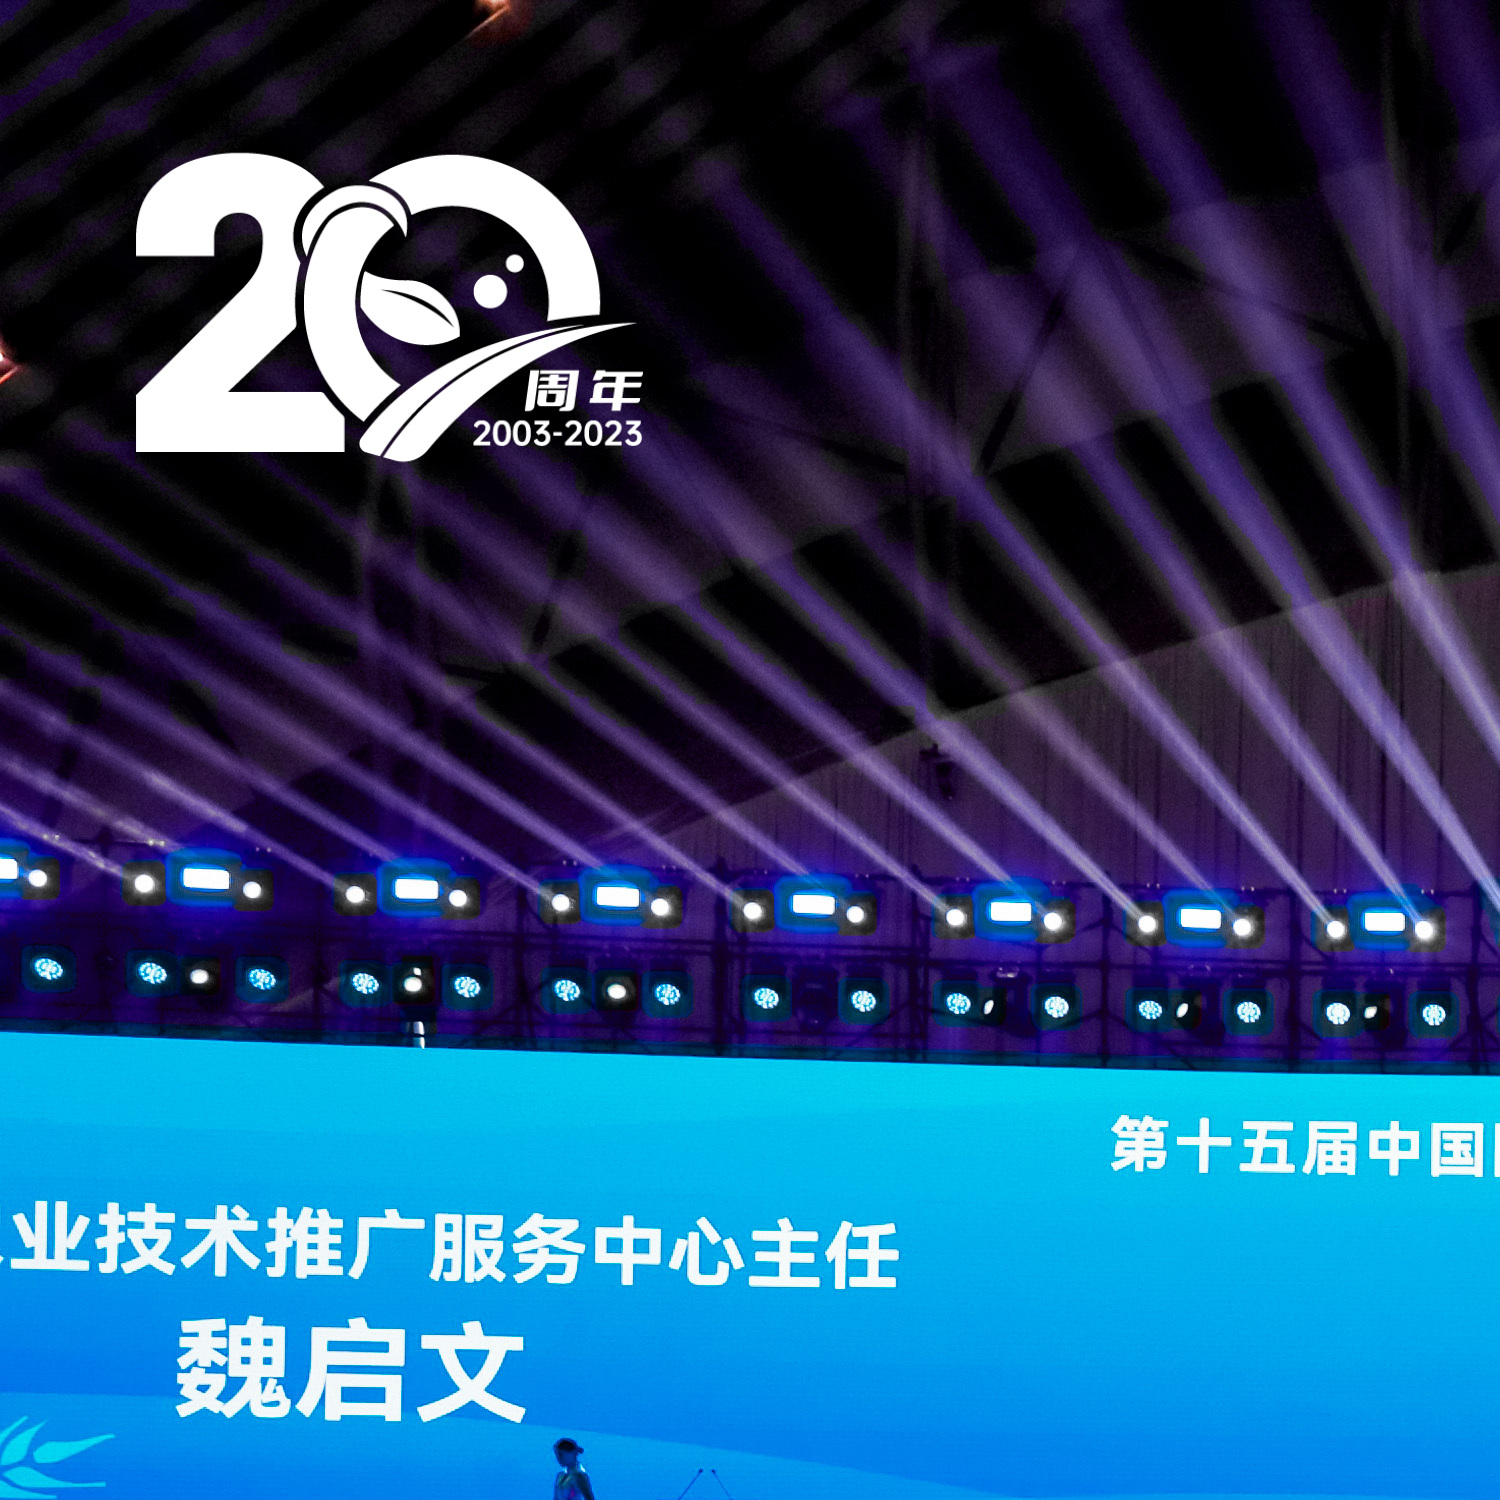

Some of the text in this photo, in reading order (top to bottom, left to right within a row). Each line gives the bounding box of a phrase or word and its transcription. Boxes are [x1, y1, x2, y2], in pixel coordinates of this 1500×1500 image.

[0, 1201, 901, 1290] 业技术推广服务中心主任
[176, 1316, 526, 1423] 魏启文
